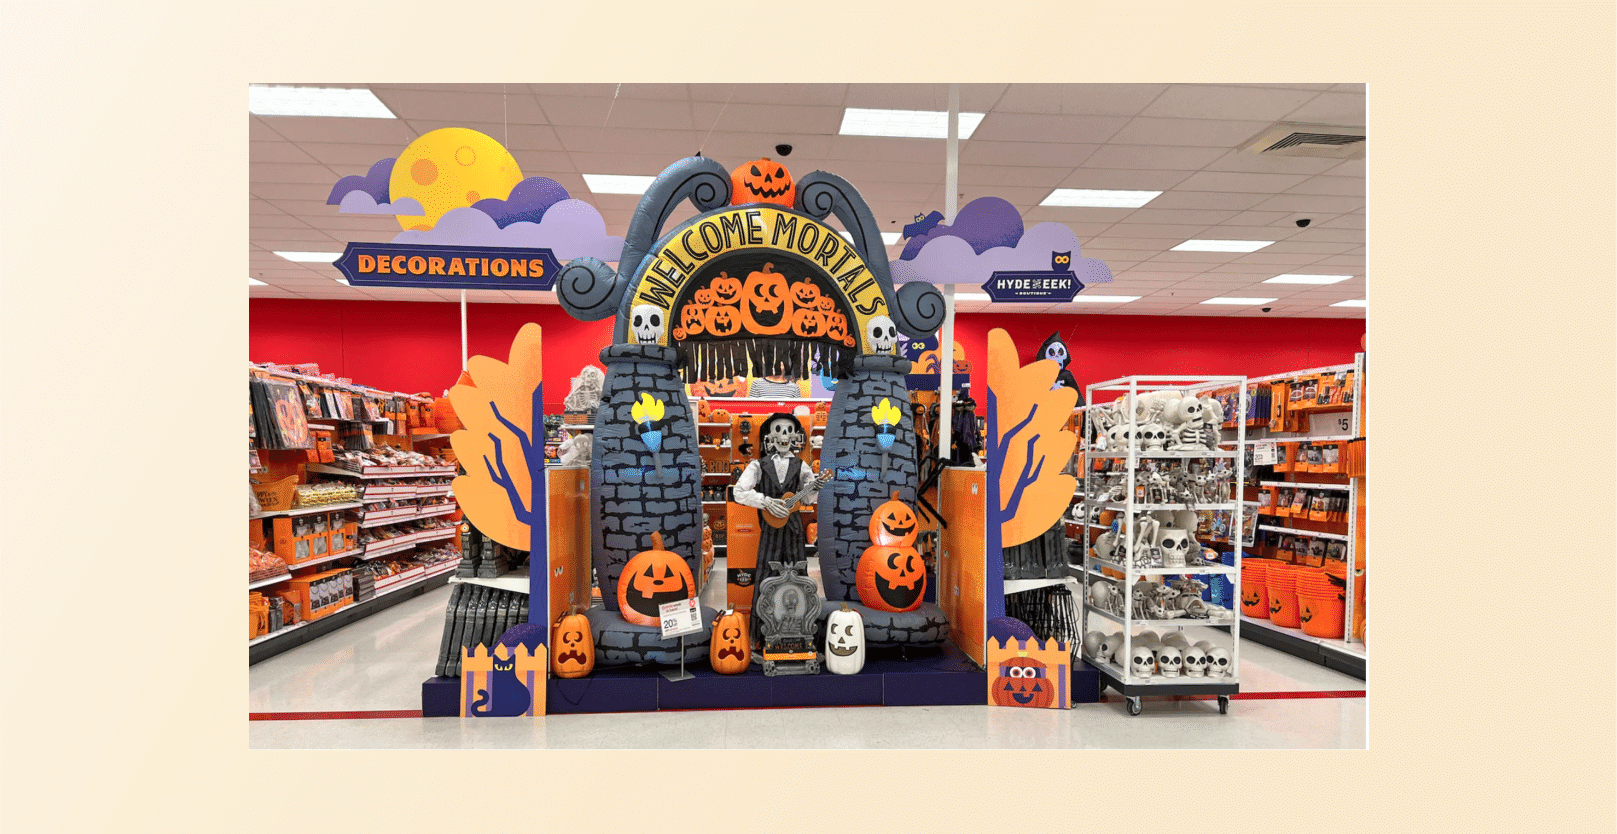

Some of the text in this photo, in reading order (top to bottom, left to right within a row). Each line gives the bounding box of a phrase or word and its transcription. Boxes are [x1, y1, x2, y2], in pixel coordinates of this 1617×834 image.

[358, 254, 544, 278] DECORATIONS
[640, 211, 885, 316] WELCOME MORTALS
[997, 278, 1031, 290] HYDE
[1042, 278, 1072, 290] EEK!
[1338, 418, 1349, 431] $5
